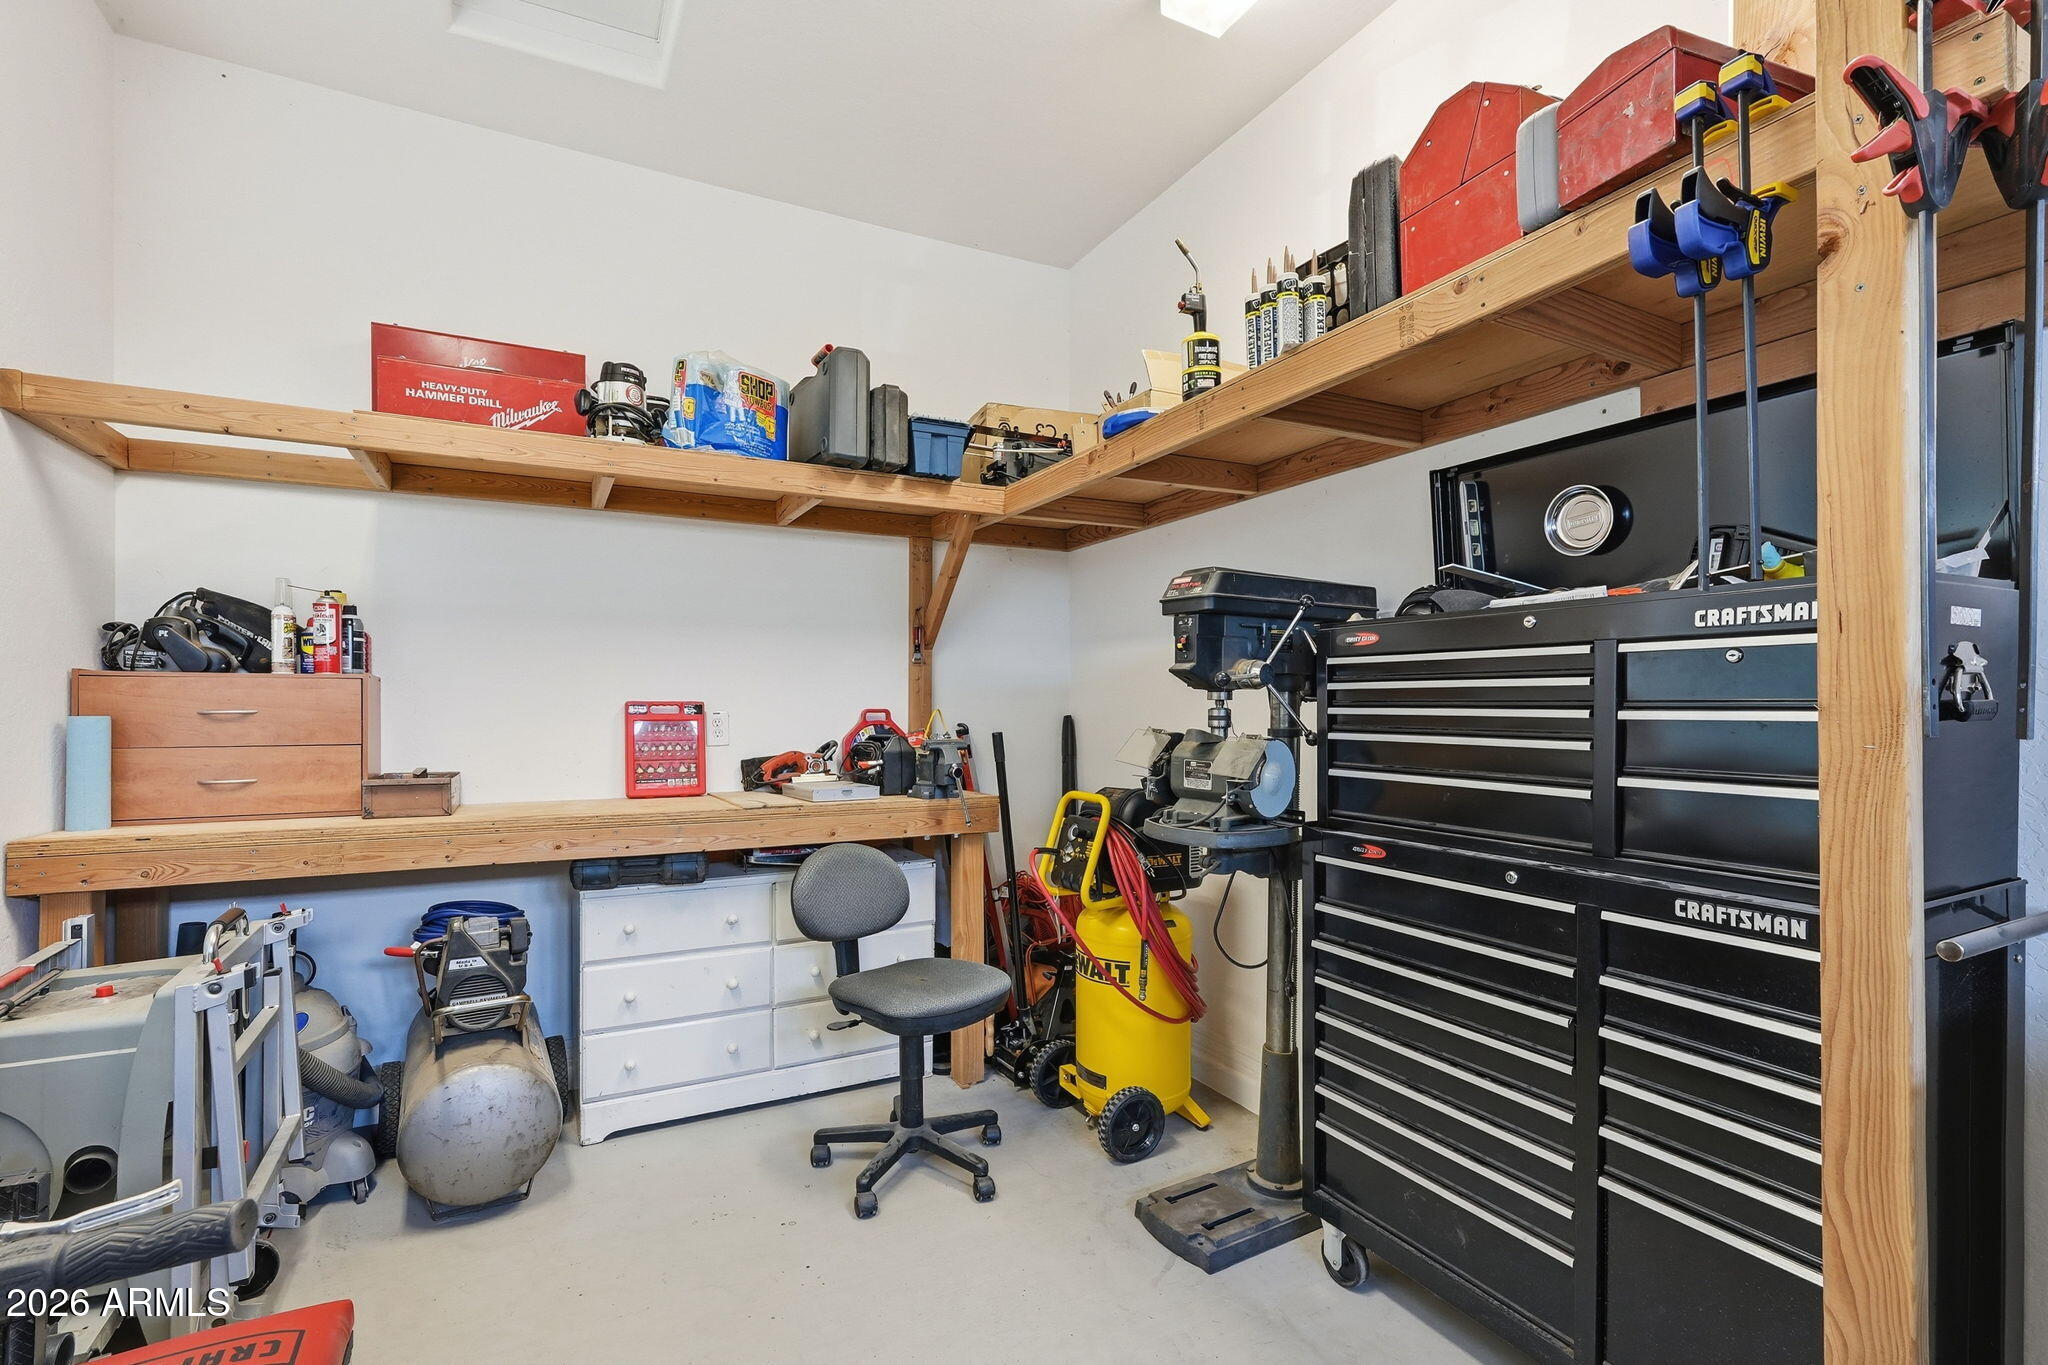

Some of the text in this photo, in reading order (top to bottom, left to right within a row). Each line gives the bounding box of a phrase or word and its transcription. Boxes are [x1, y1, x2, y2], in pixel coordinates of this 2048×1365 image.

[1759, 217, 1767, 257] IRWIN
[405, 388, 502, 409] HAMMER DRILL
[421, 381, 488, 396] HEAVY-DUTY
[740, 374, 775, 401] SHOP
[489, 400, 561, 429] Milwaukee
[1675, 899, 1807, 940] CRAFTSMAN
